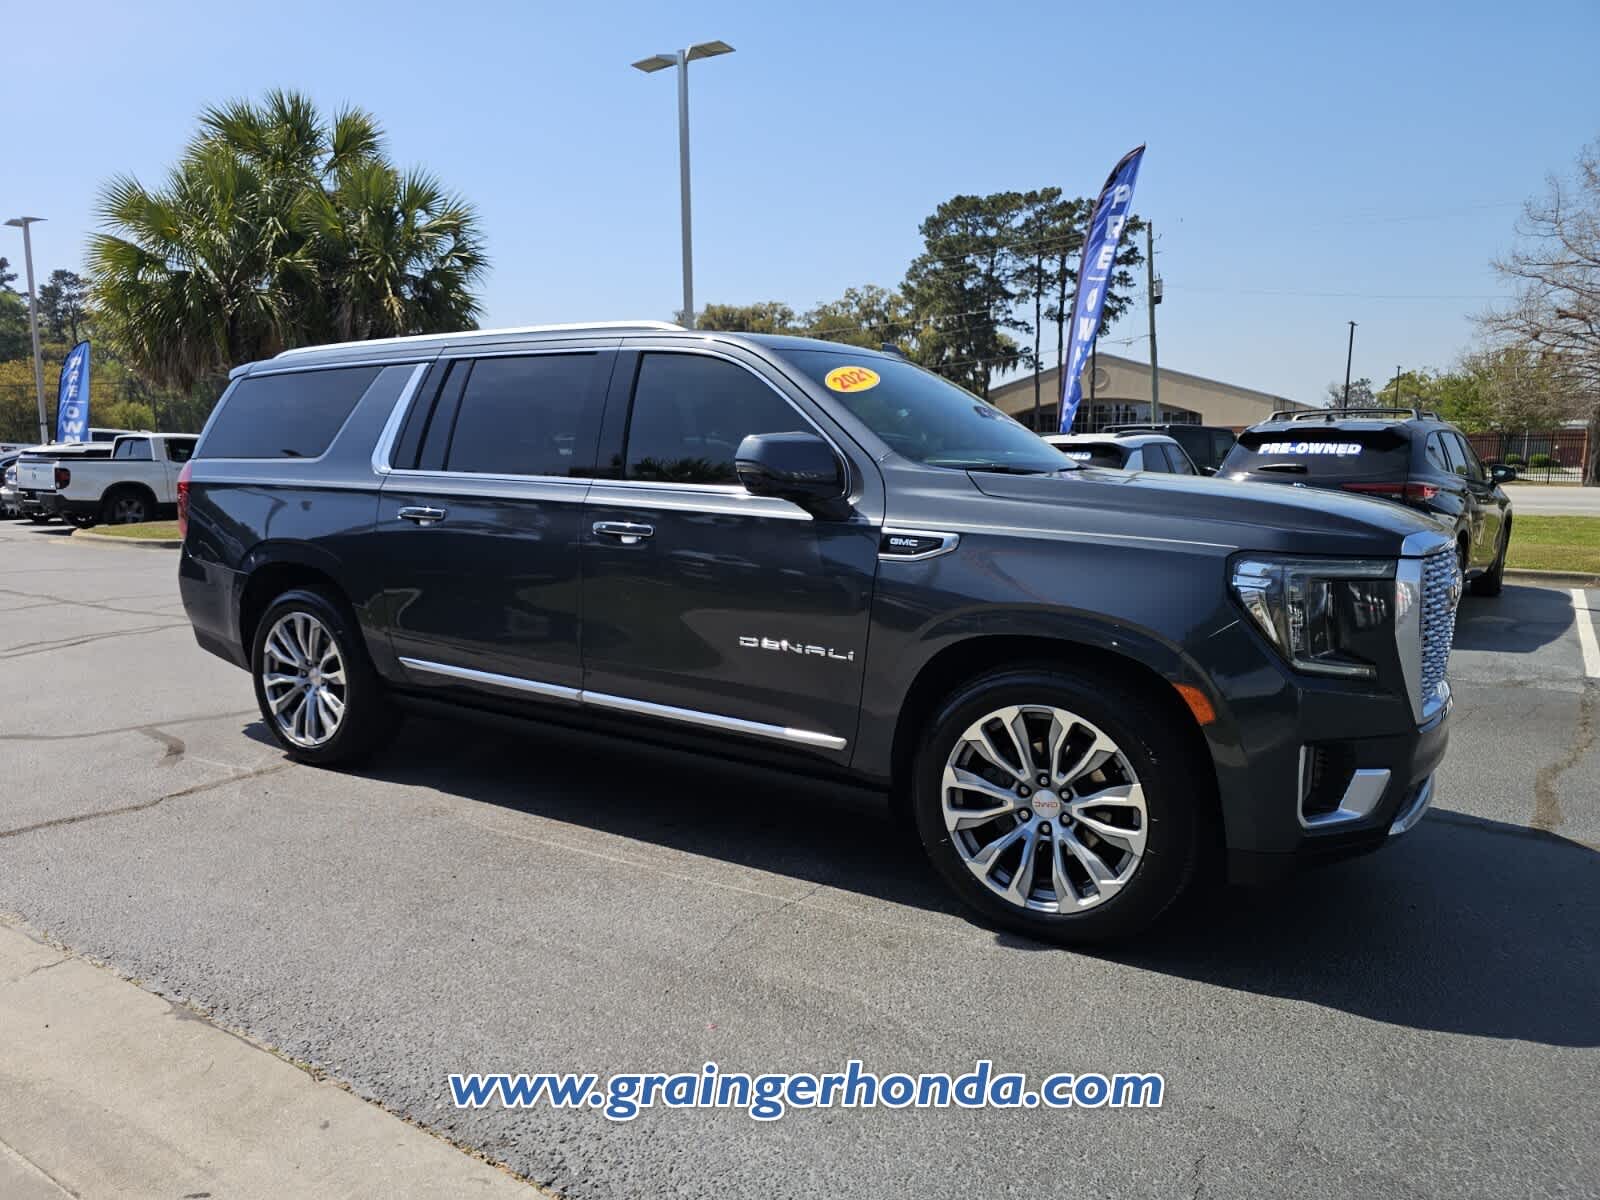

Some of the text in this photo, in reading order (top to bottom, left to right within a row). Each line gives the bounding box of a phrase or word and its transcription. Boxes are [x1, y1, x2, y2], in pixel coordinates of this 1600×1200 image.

[832, 369, 873, 390] 2021
[1258, 442, 1362, 454] PRE-OWNED
[889, 537, 918, 547] GMC
[739, 636, 855, 662] DENALI
